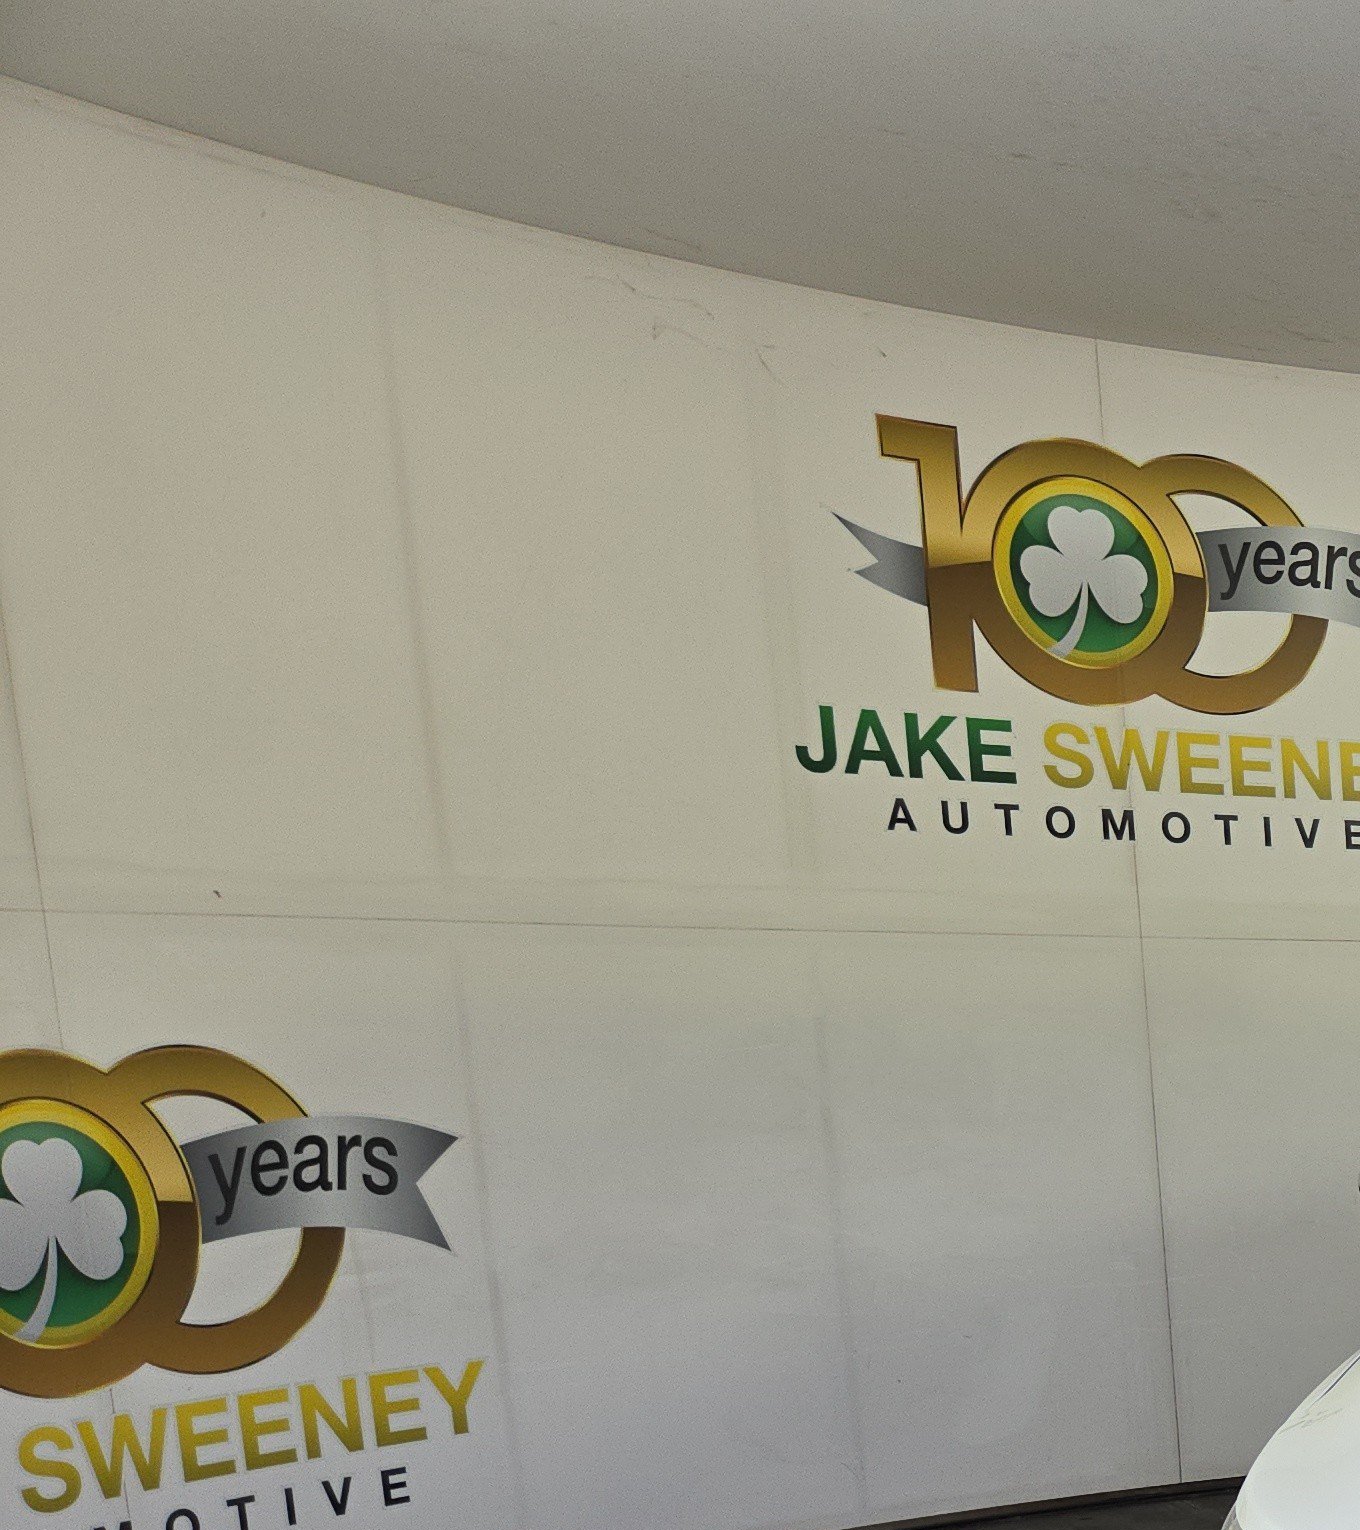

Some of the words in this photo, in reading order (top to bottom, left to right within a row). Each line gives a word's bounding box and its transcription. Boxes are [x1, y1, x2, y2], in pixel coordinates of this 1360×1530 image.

[875, 413, 1329, 715] 100
[794, 704, 1018, 785] JAKE
[207, 1131, 399, 1226] years
[17, 1359, 484, 1513] SWEENEY
